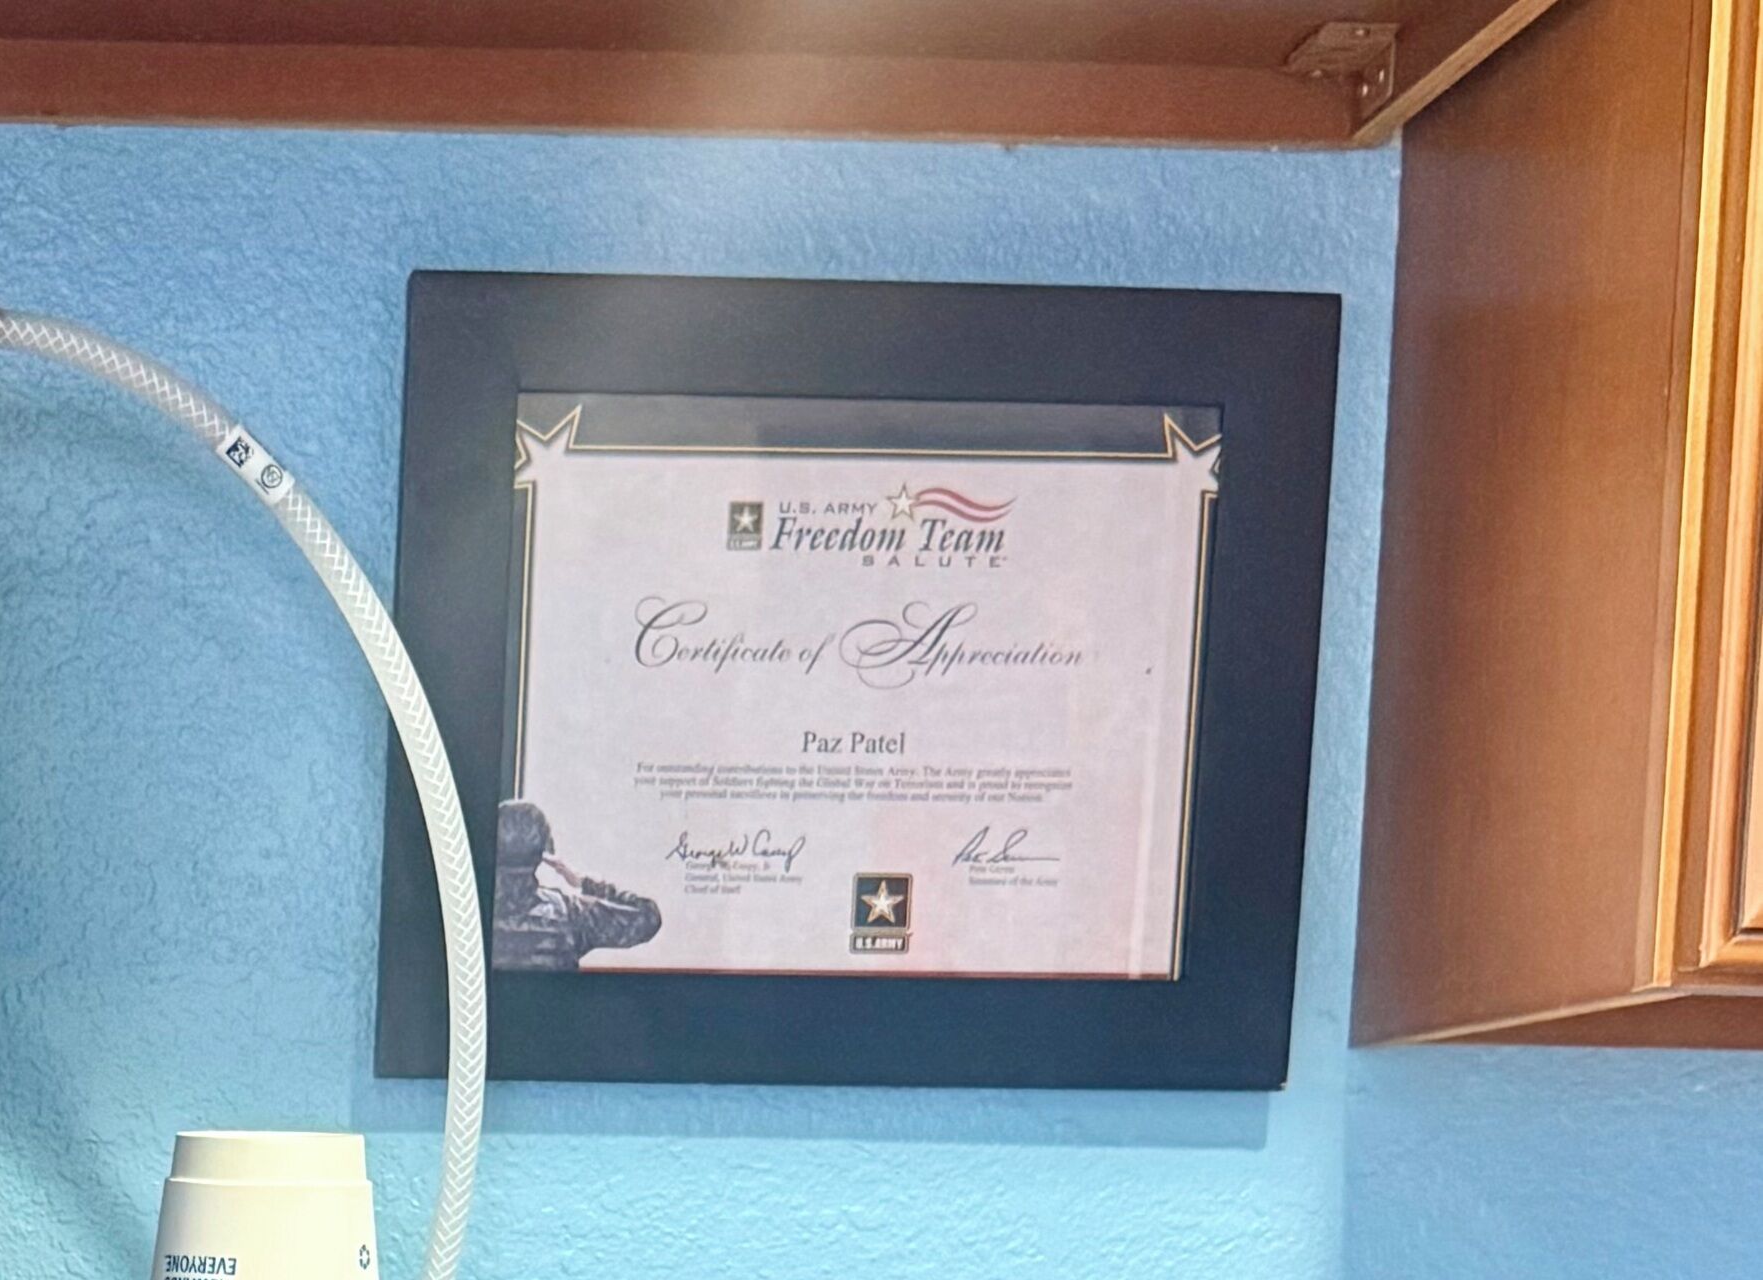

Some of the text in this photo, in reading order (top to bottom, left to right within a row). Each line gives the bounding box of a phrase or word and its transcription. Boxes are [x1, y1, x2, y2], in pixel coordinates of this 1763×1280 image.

[779, 502, 878, 515] U.S. ARMY
[770, 516, 1006, 554] Freedom Team
[861, 556, 1002, 568] SALUTE
[635, 595, 1083, 689] Certificate of Appreciation
[802, 731, 906, 755] Paz Patel
[164, 1254, 237, 1275] EVERYONE
